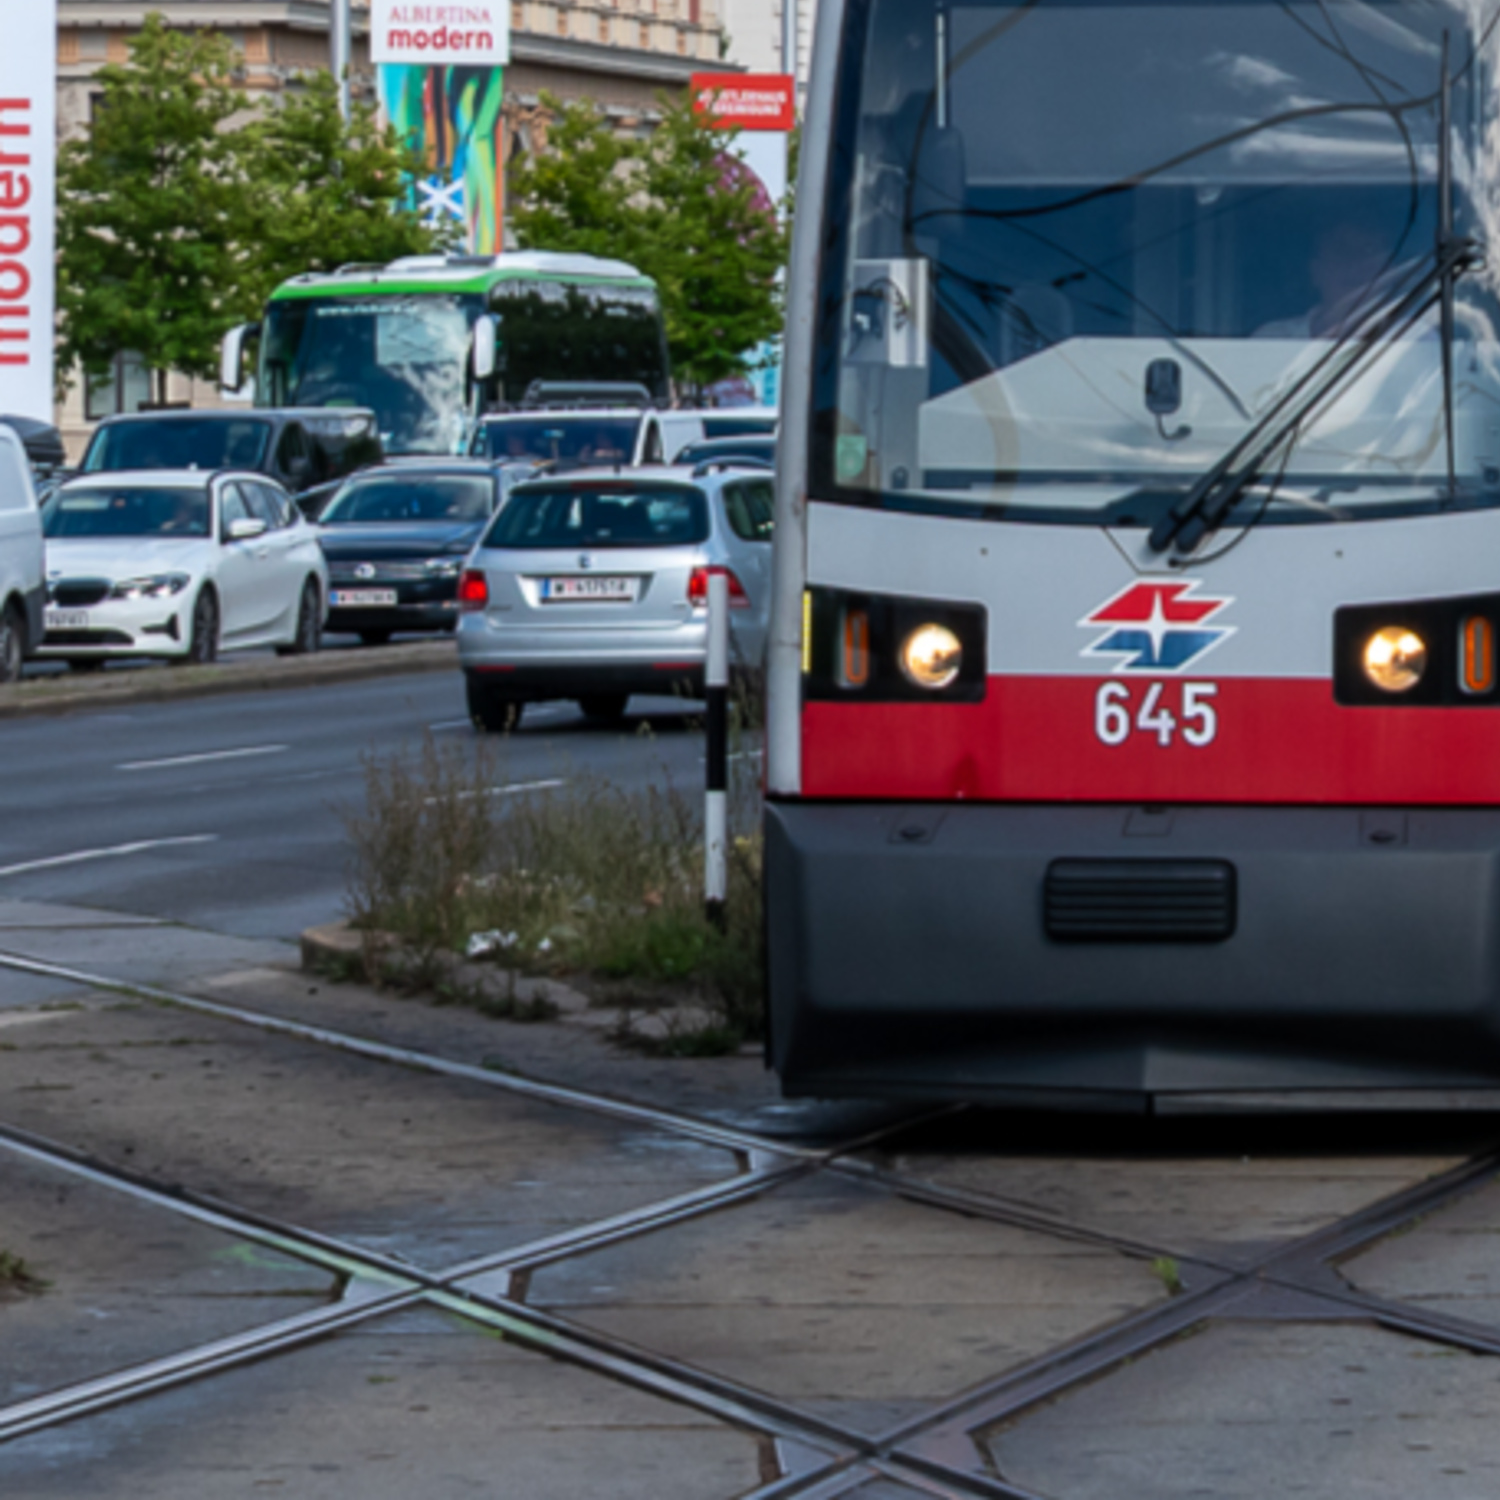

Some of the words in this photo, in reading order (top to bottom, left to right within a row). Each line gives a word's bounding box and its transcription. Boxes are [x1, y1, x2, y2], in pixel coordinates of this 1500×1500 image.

[388, 5, 493, 23] ALBERTINA
[387, 25, 494, 51] modern
[1094, 679, 1218, 747] 645
